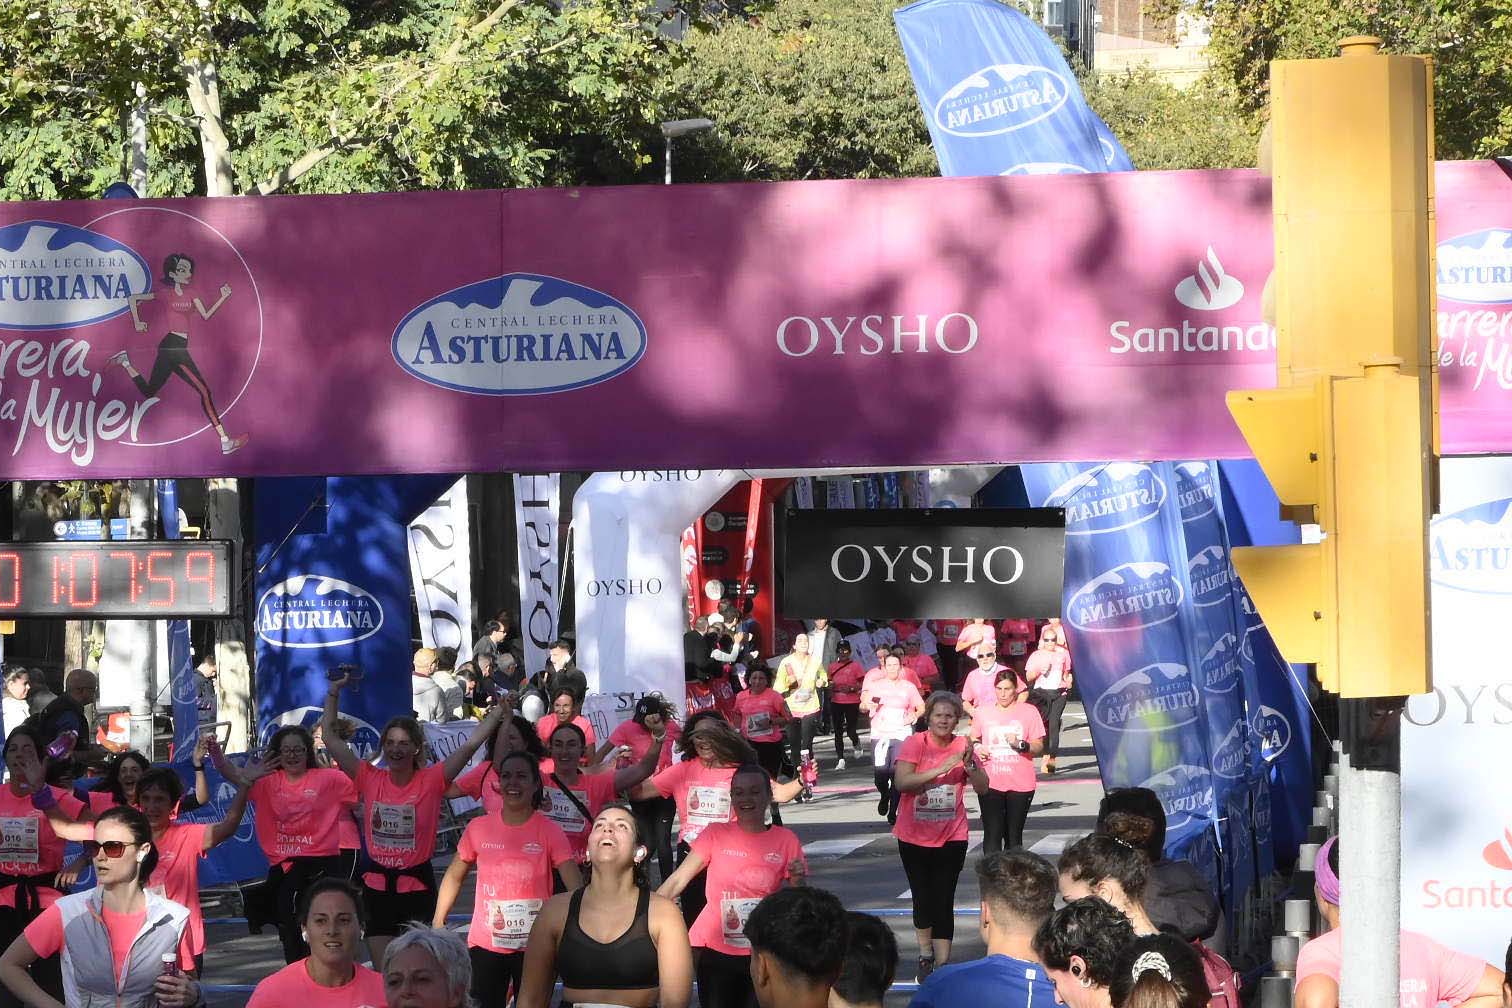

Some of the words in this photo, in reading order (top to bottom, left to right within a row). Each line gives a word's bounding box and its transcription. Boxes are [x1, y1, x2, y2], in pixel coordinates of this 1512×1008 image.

[54, 257, 127, 269] LECHERA
[451, 315, 529, 328] CENTRAL
[538, 313, 620, 326] LECHERA
[775, 312, 979, 357] OYSHO
[411, 320, 627, 366] ASTURIANA
[11, 373, 161, 467] Mujer
[522, 474, 554, 650] OYSH
[831, 544, 1024, 584] OYSHO
[587, 578, 662, 597] OYSHO
[261, 604, 374, 632] ASTURIANA
